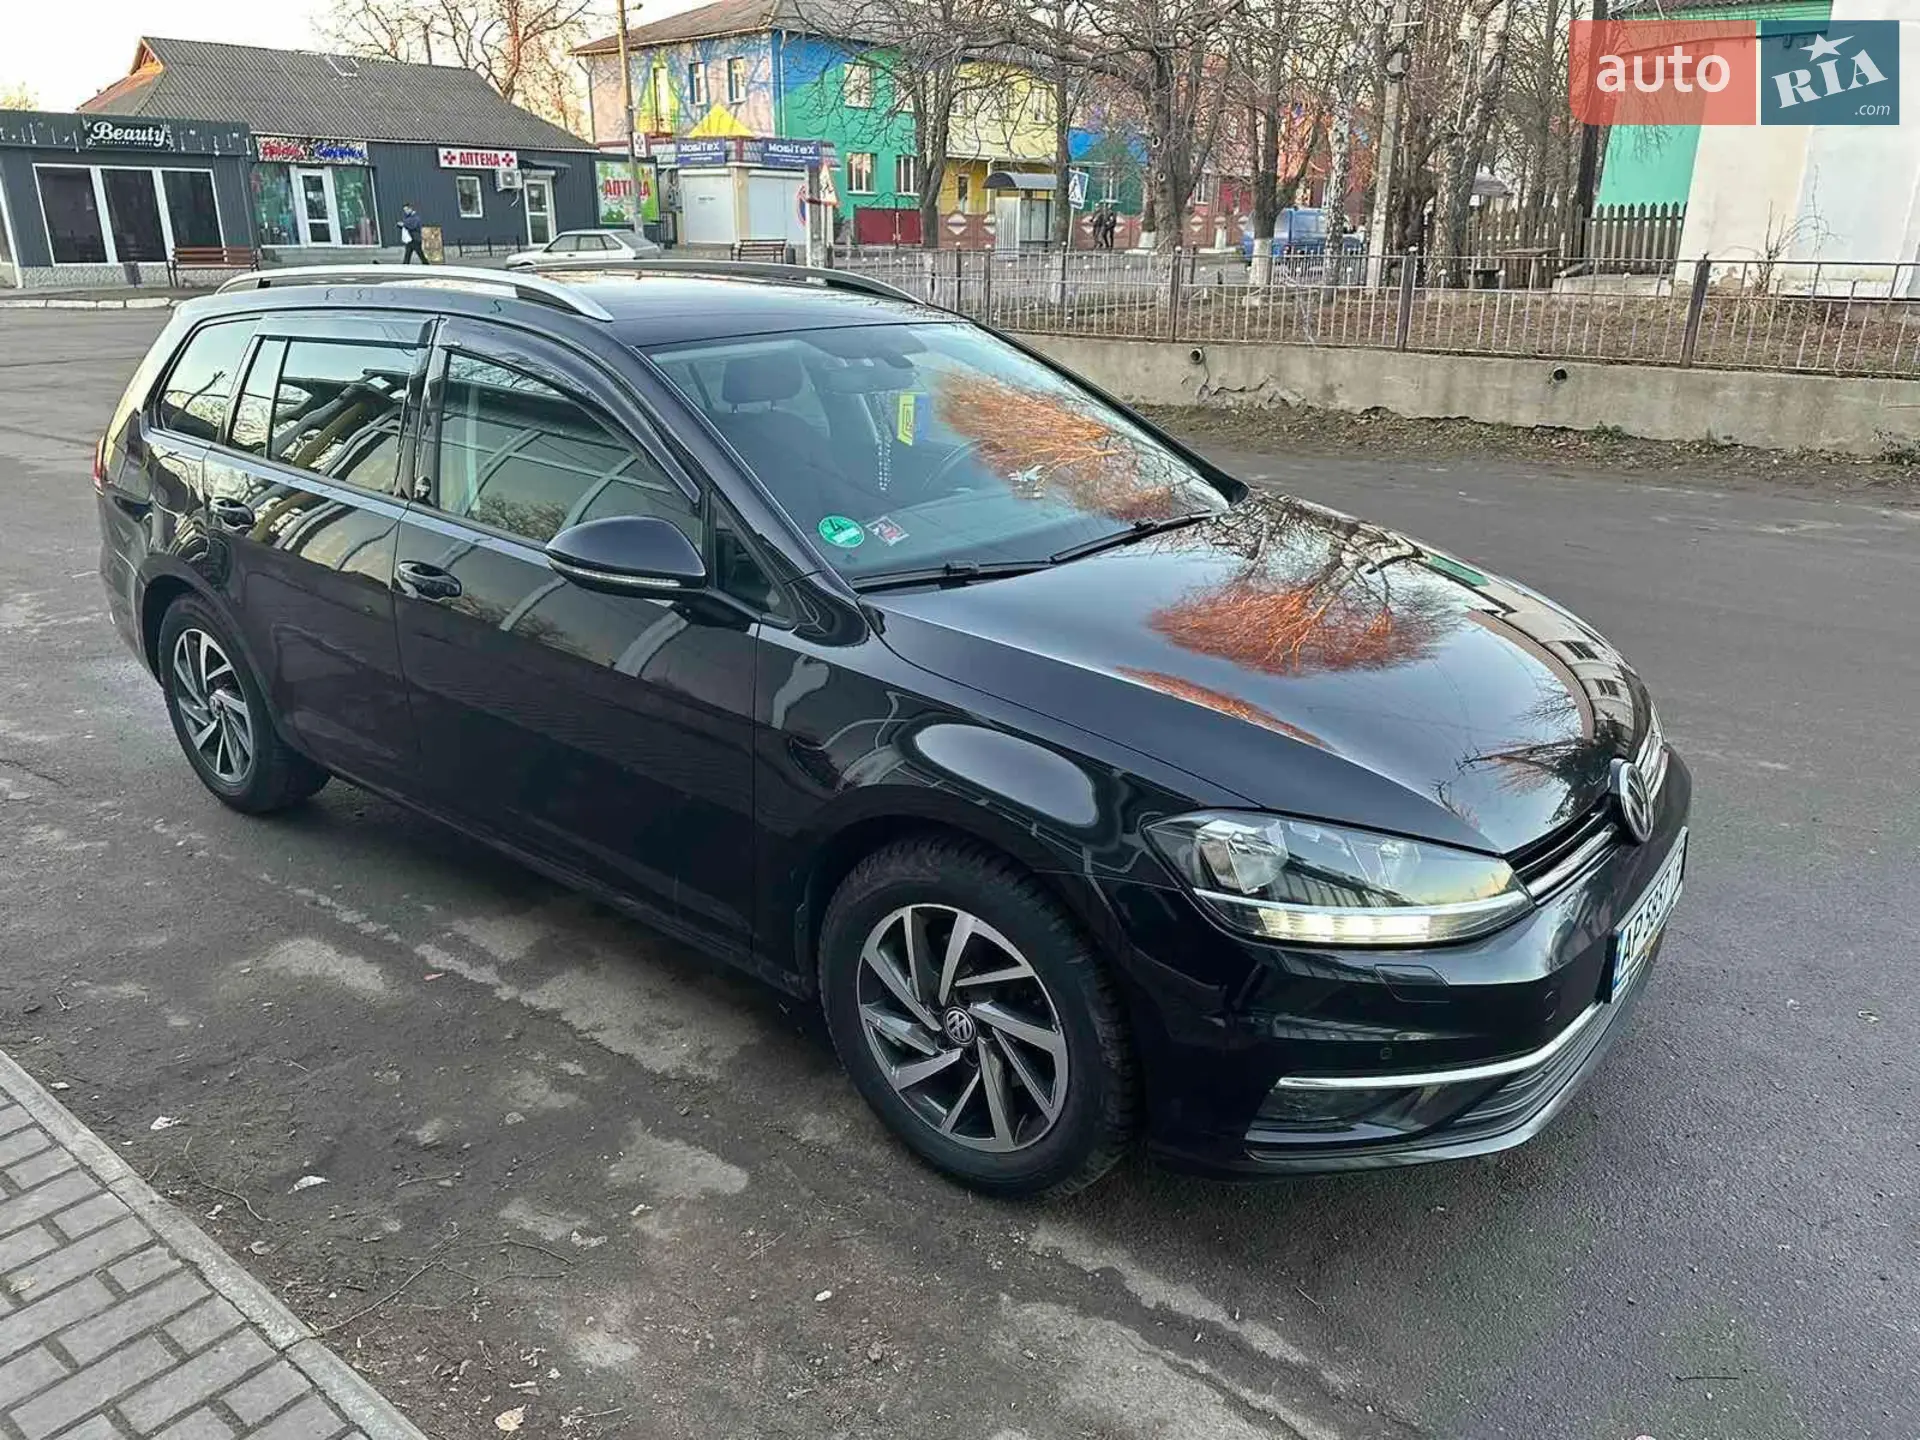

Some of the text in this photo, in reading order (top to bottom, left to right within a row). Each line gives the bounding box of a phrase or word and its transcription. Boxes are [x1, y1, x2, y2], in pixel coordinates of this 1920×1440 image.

[90, 121, 166, 147] Beauty
[460, 151, 500, 166] АПТЕКА
[603, 179, 651, 197] АПТА
